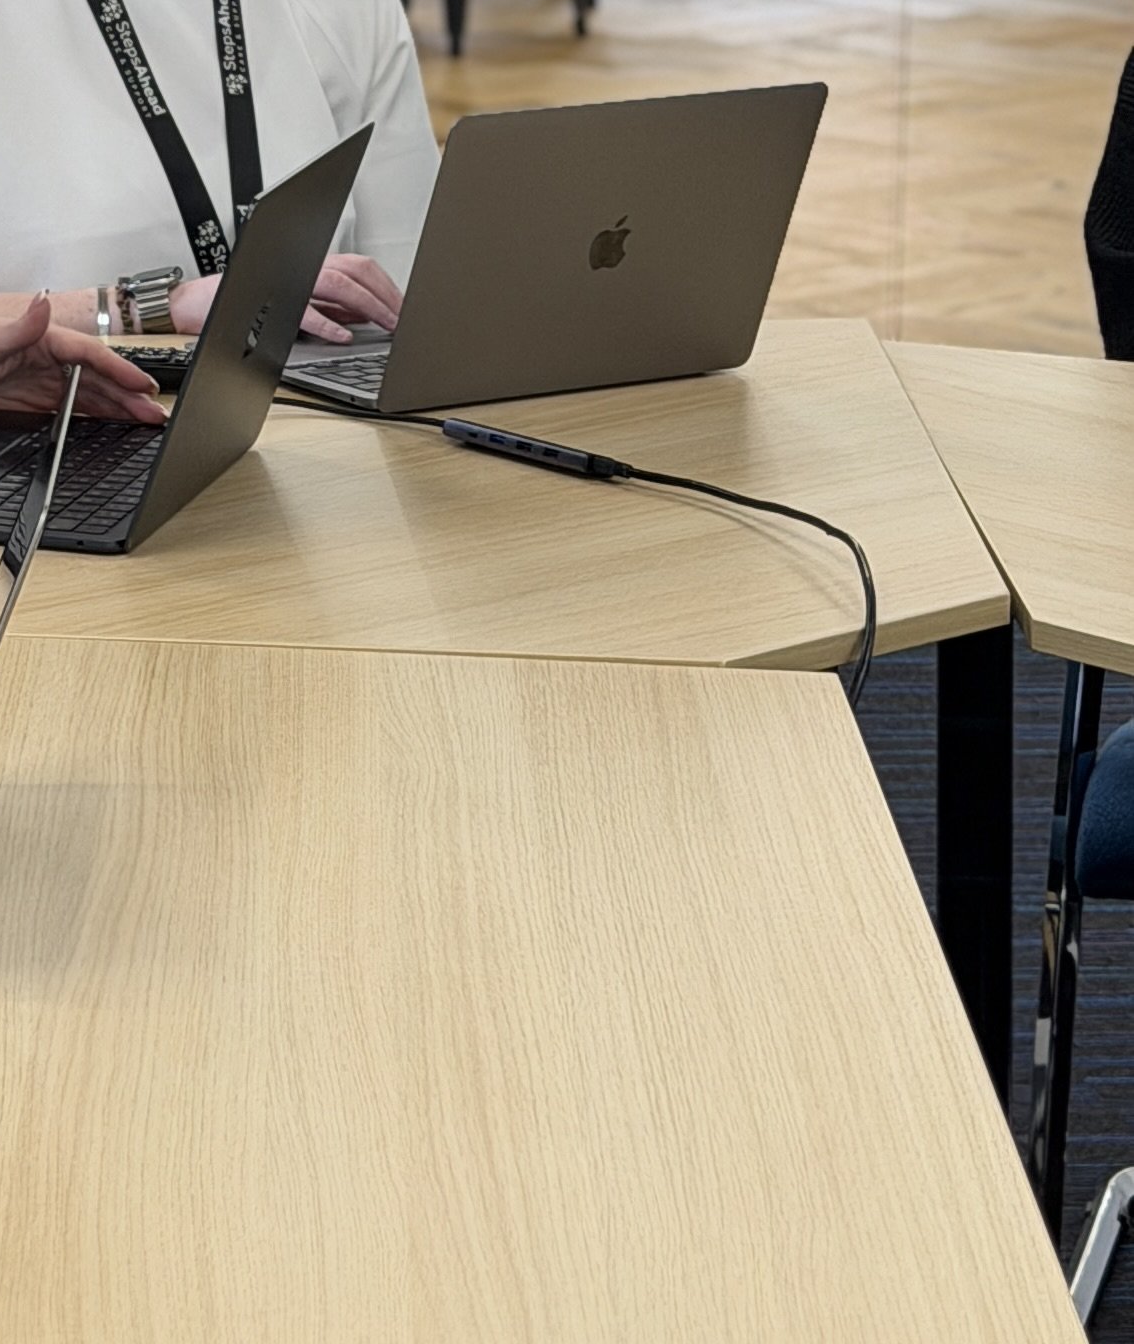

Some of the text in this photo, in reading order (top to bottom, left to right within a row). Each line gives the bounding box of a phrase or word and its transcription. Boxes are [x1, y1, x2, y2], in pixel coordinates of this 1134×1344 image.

[106, 25, 122, 54] CARE
[125, 69, 152, 118] SUPPORT
[115, 20, 166, 116] StepsAhead
